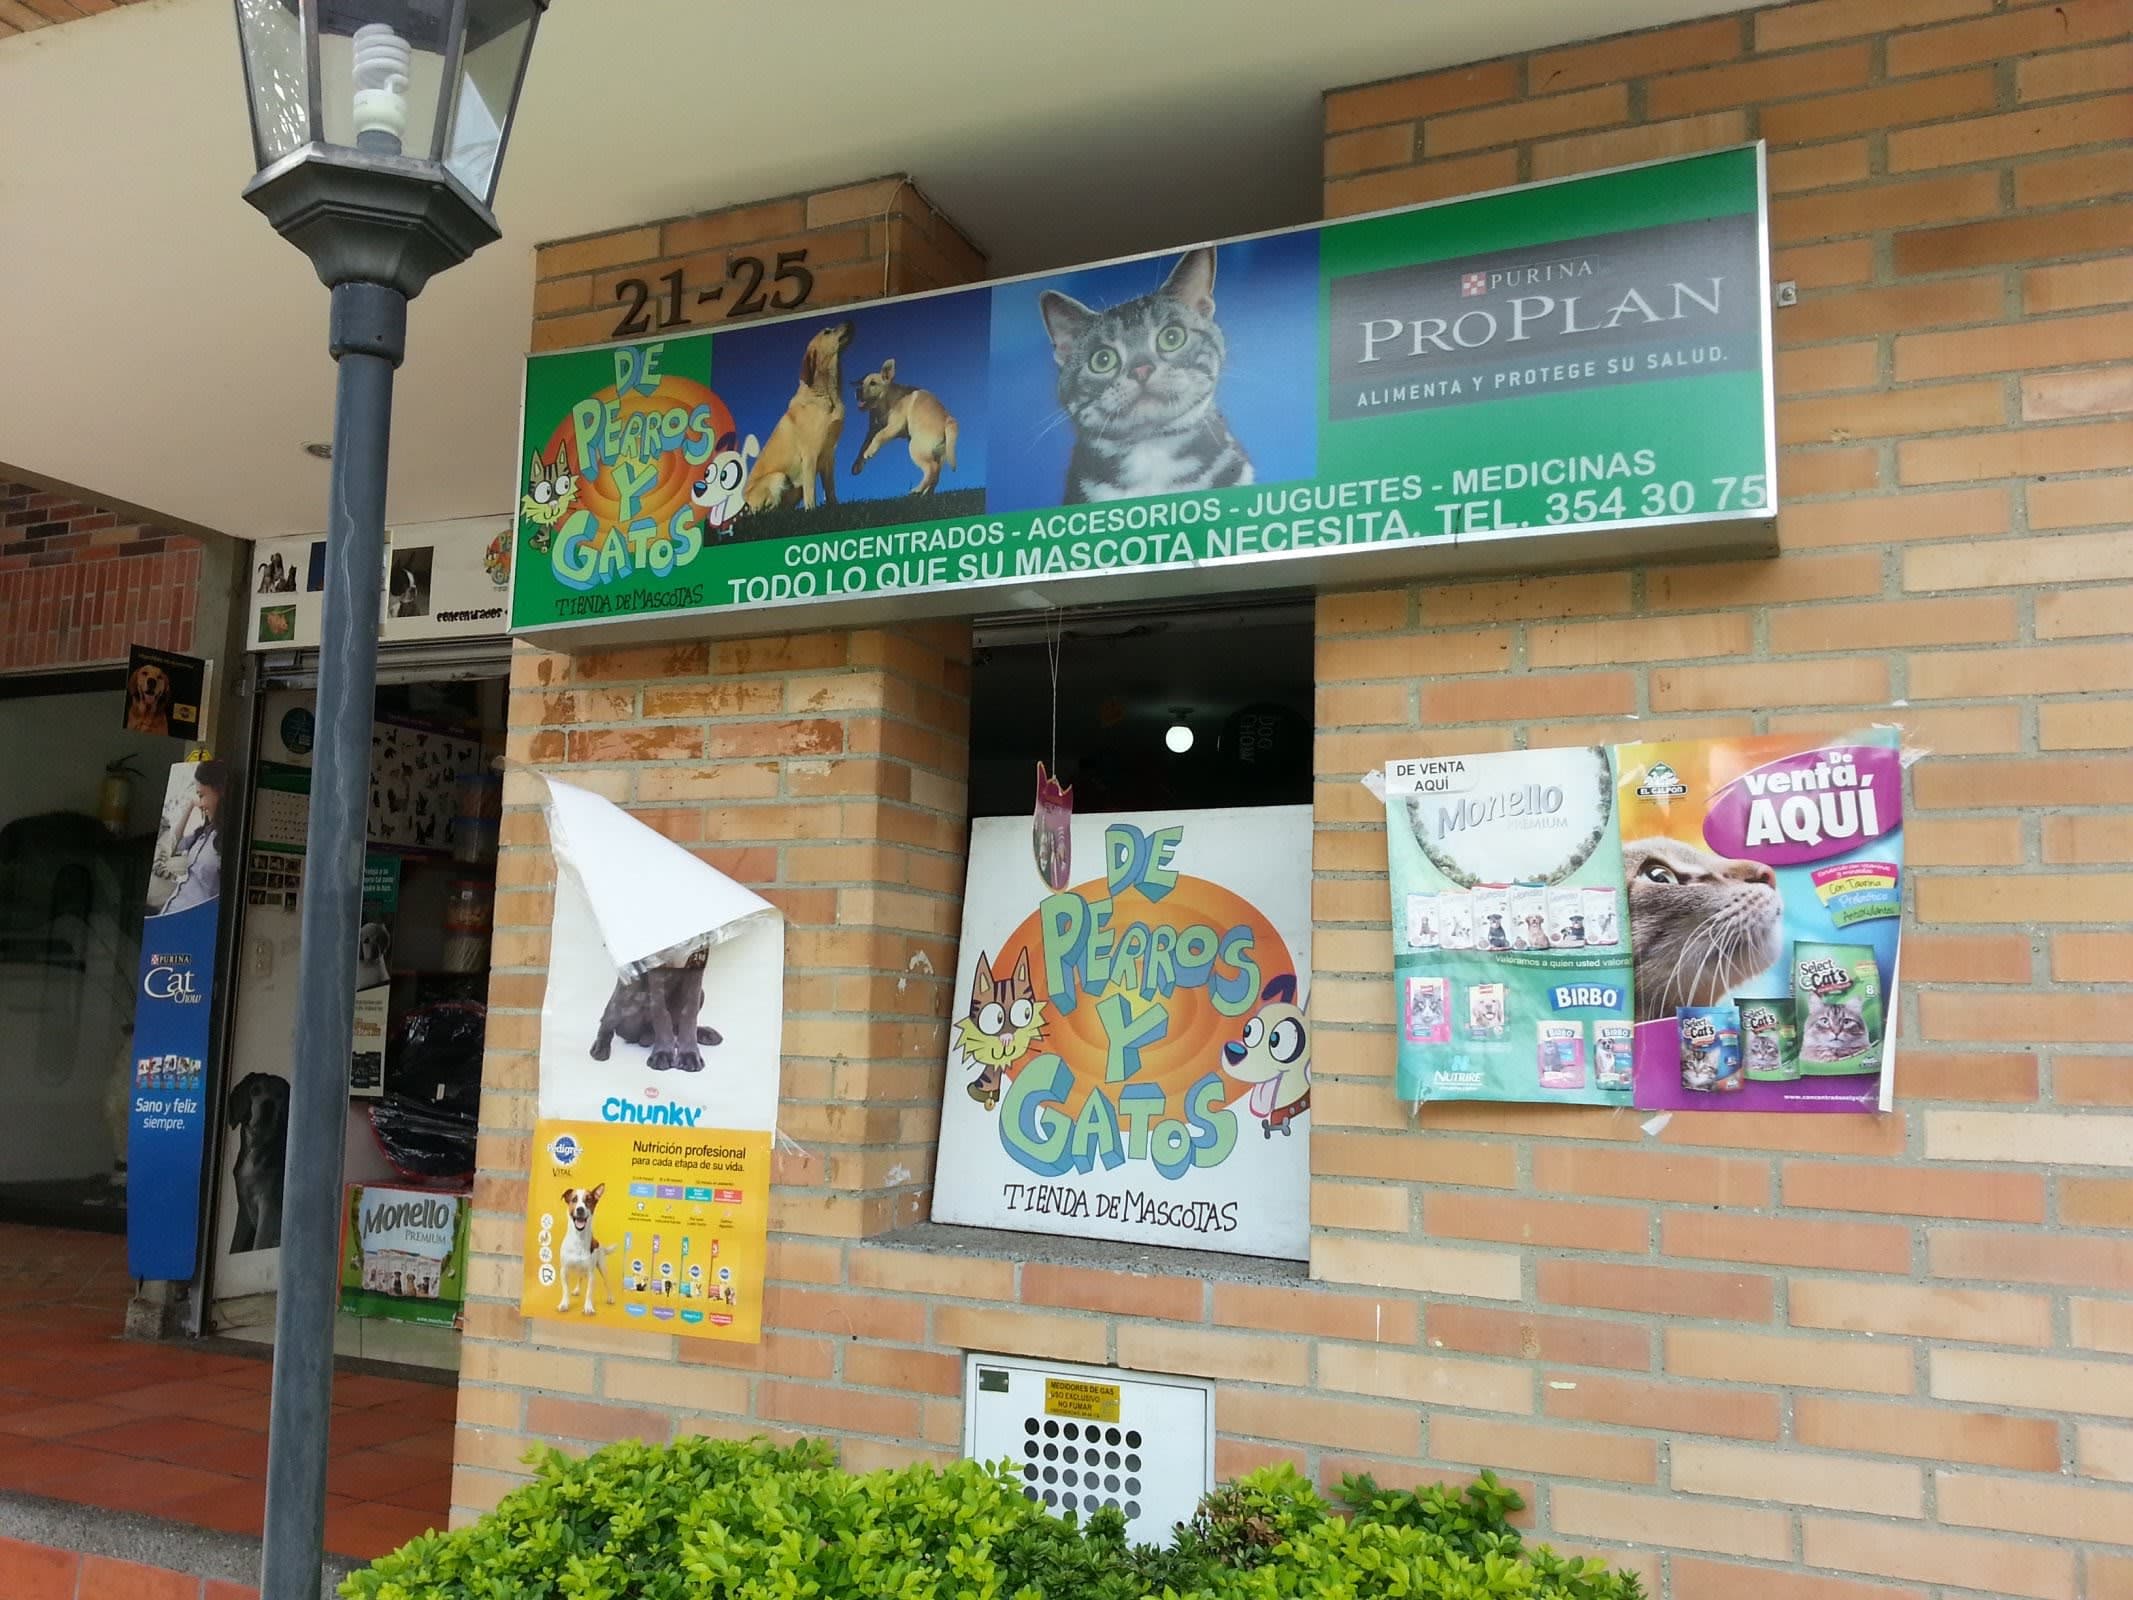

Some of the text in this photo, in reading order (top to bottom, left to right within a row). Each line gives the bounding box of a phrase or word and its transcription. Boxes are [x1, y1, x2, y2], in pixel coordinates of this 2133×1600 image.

[1490, 260, 1592, 290] PURINA
[611, 249, 815, 337] 21-25
[614, 343, 665, 397] DE
[1357, 346, 1729, 408] ALIMENTA Y PROTEGE SU SALUD.
[572, 399, 716, 483] PERROS
[611, 462, 659, 523] Y
[784, 523, 1005, 567] CONCENTRADOS
[1027, 497, 1221, 541] ACCESORIOS
[1253, 474, 1423, 516] JUGUETES
[1452, 449, 1657, 495] MEDICINAS
[552, 504, 703, 592] GATOS
[728, 571, 818, 604] TODO
[826, 564, 868, 596] LO
[876, 556, 945, 589] QUE
[957, 551, 1004, 582] SU
[1016, 531, 1194, 577] MASCOTA
[1435, 498, 1529, 537] TEL.
[1545, 486, 1626, 525] 354
[1640, 480, 1696, 517] 30
[1711, 473, 1766, 511] 75
[556, 593, 613, 617] TIENDA
[1396, 760, 1465, 777] DE VENTA
[1830, 752, 1853, 765] De
[1414, 776, 1450, 792] AQUÍ
[1438, 783, 1564, 840] Monello
[1507, 817, 1569, 831] PREMIUM
[1746, 774, 1880, 847] AQUÍ
[1105, 824, 1184, 903] DE
[159, 955, 190, 966] PURINA
[1040, 891, 1262, 1018] PERROS
[1549, 958, 1575, 970] quien
[1576, 957, 1601, 968] usted
[1800, 960, 1834, 976] Select
[144, 967, 196, 999] Cat
[1811, 969, 1848, 989] Cat's
[1555, 987, 1618, 1008] BIRBO
[1095, 994, 1170, 1083] Y
[1690, 1026, 1715, 1039] Cat's
[135, 1097, 198, 1116] Sano y feliz
[602, 1097, 702, 1127] Chunky
[1000, 1052, 1239, 1179] GATOS
[143, 1116, 186, 1131] siempre.
[633, 1140, 746, 1160] Nutrición profesional
[631, 1156, 745, 1172] para cada etapa de su vida.
[363, 1198, 450, 1239] Monello
[1003, 1184, 1239, 1232] TIENDA DE MASCOTAS
[405, 1229, 446, 1245] PREMIUM
[1050, 1381, 1114, 1395] MEDIDORES DE GAS
[1065, 1393, 1100, 1403] EXCLUSIVO
[1058, 1400, 1092, 1410] NO FUMAR
